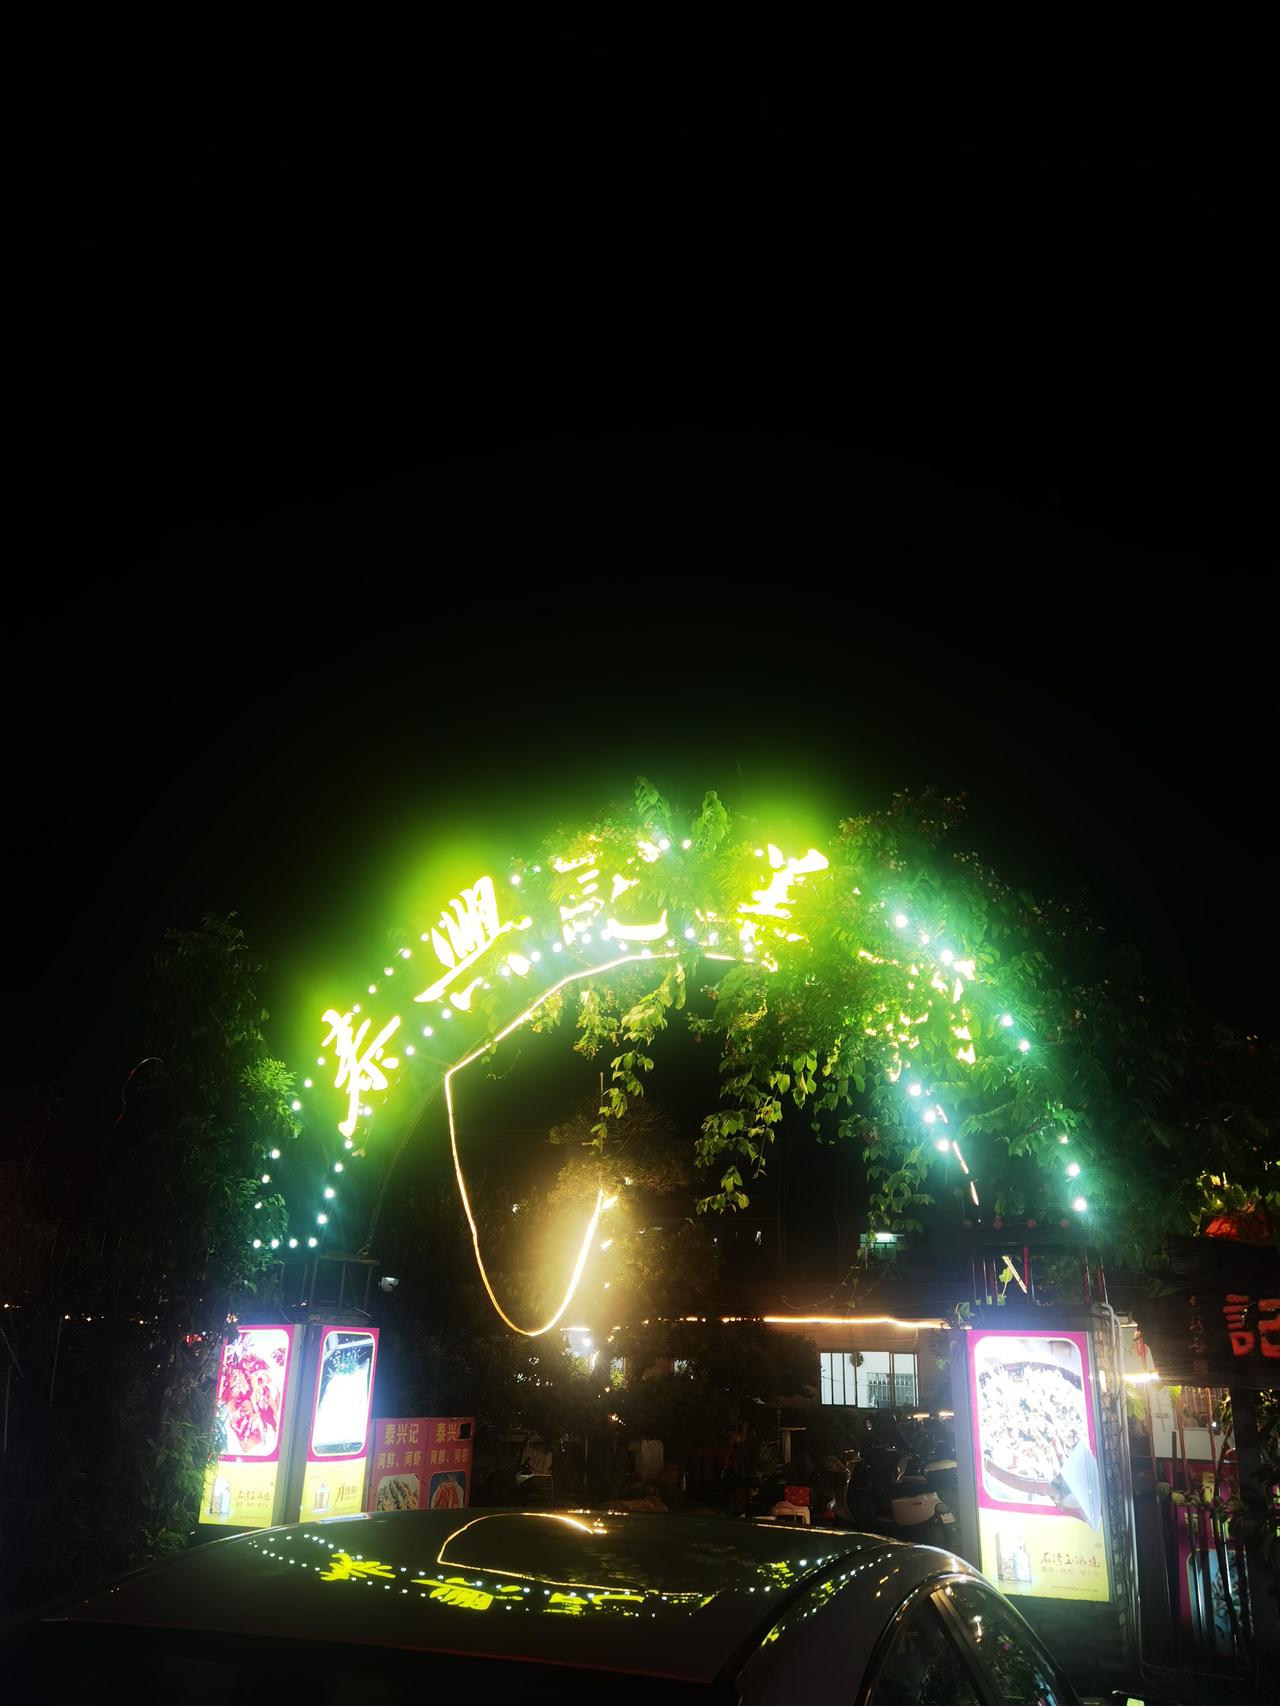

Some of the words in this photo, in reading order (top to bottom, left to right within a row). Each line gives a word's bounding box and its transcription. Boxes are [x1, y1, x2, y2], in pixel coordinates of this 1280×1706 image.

[384, 1423, 419, 1446] 泰兴记
[435, 1422, 463, 1444] 泰兴
